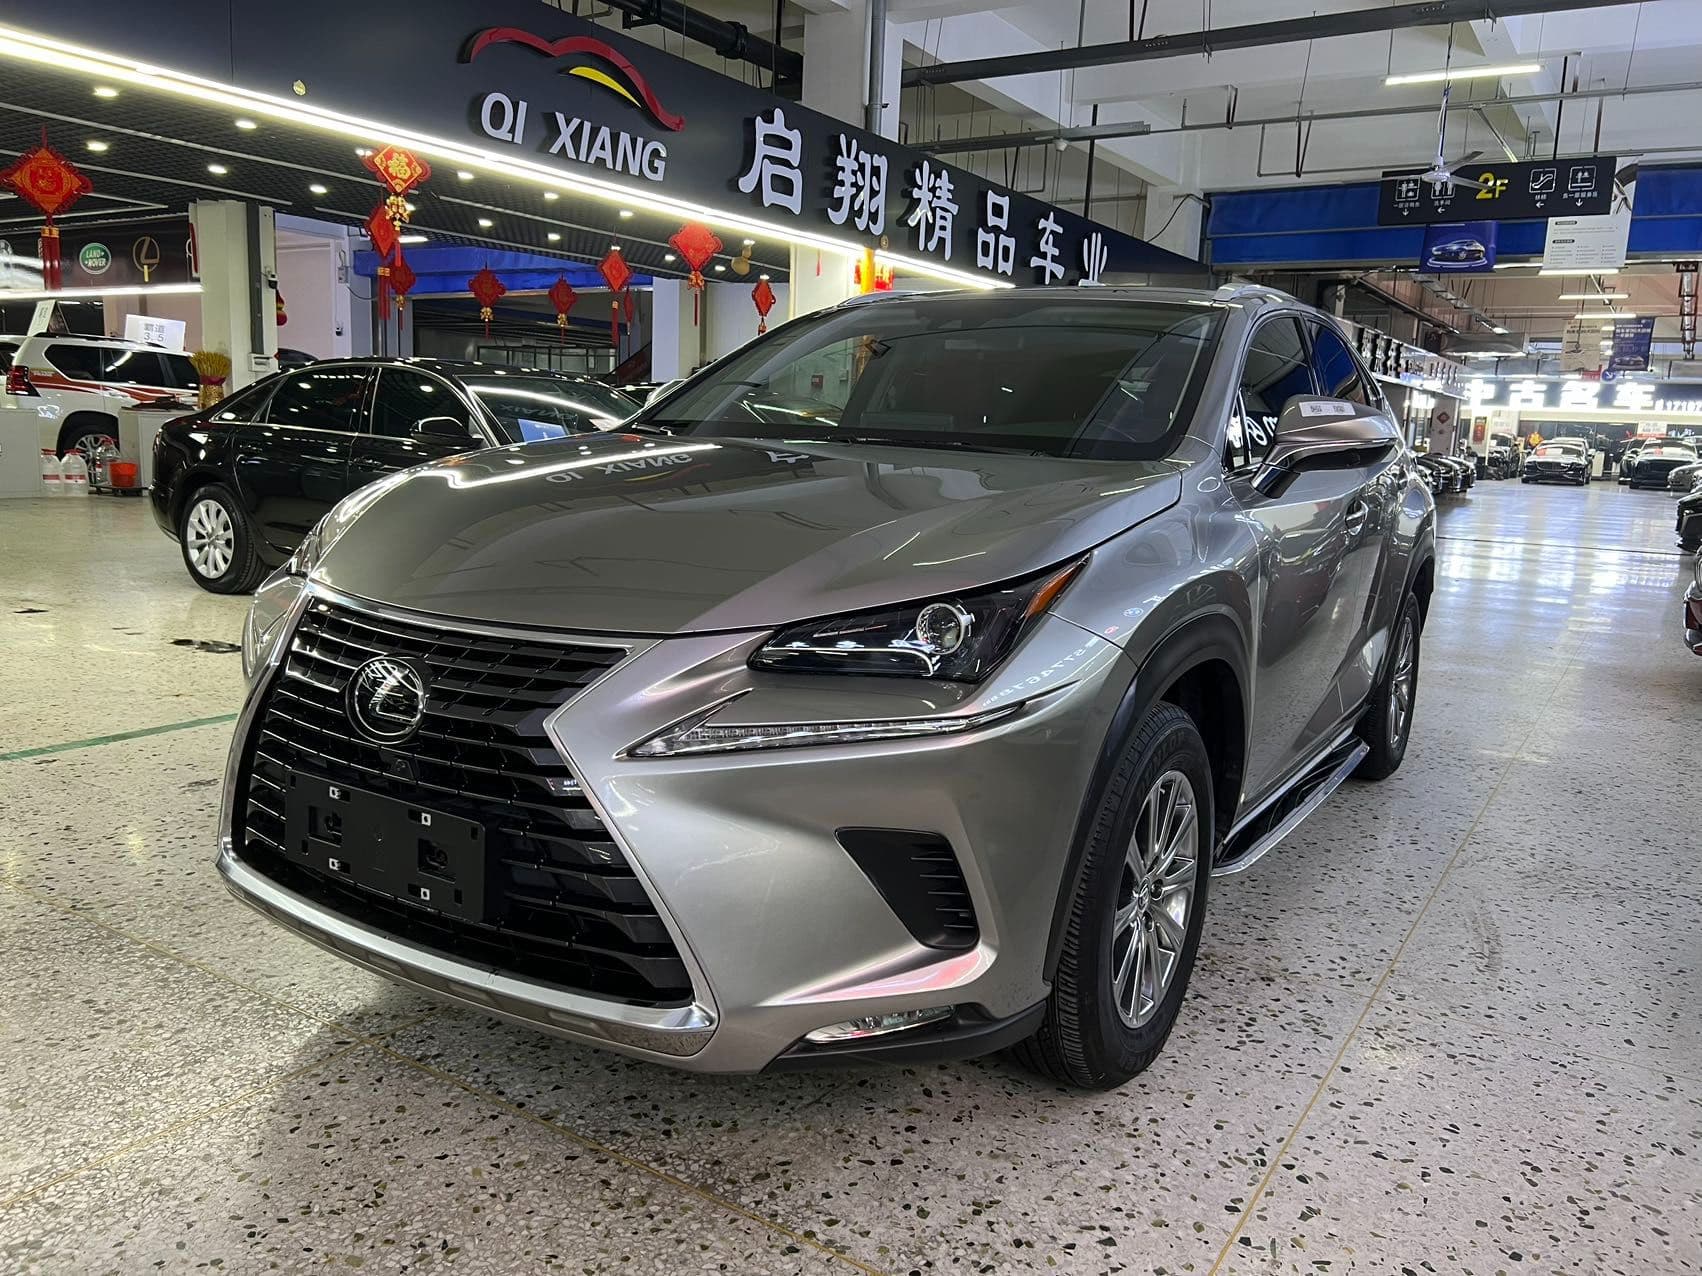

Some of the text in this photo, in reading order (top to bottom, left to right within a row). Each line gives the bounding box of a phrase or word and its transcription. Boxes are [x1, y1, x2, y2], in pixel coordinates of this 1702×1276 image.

[481, 92, 667, 182] QI XIANG
[738, 107, 1108, 287] 启翔精品车业
[1475, 171, 1509, 200] 2F
[86, 249, 101, 258] LAND
[87, 258, 107, 267] ROVER
